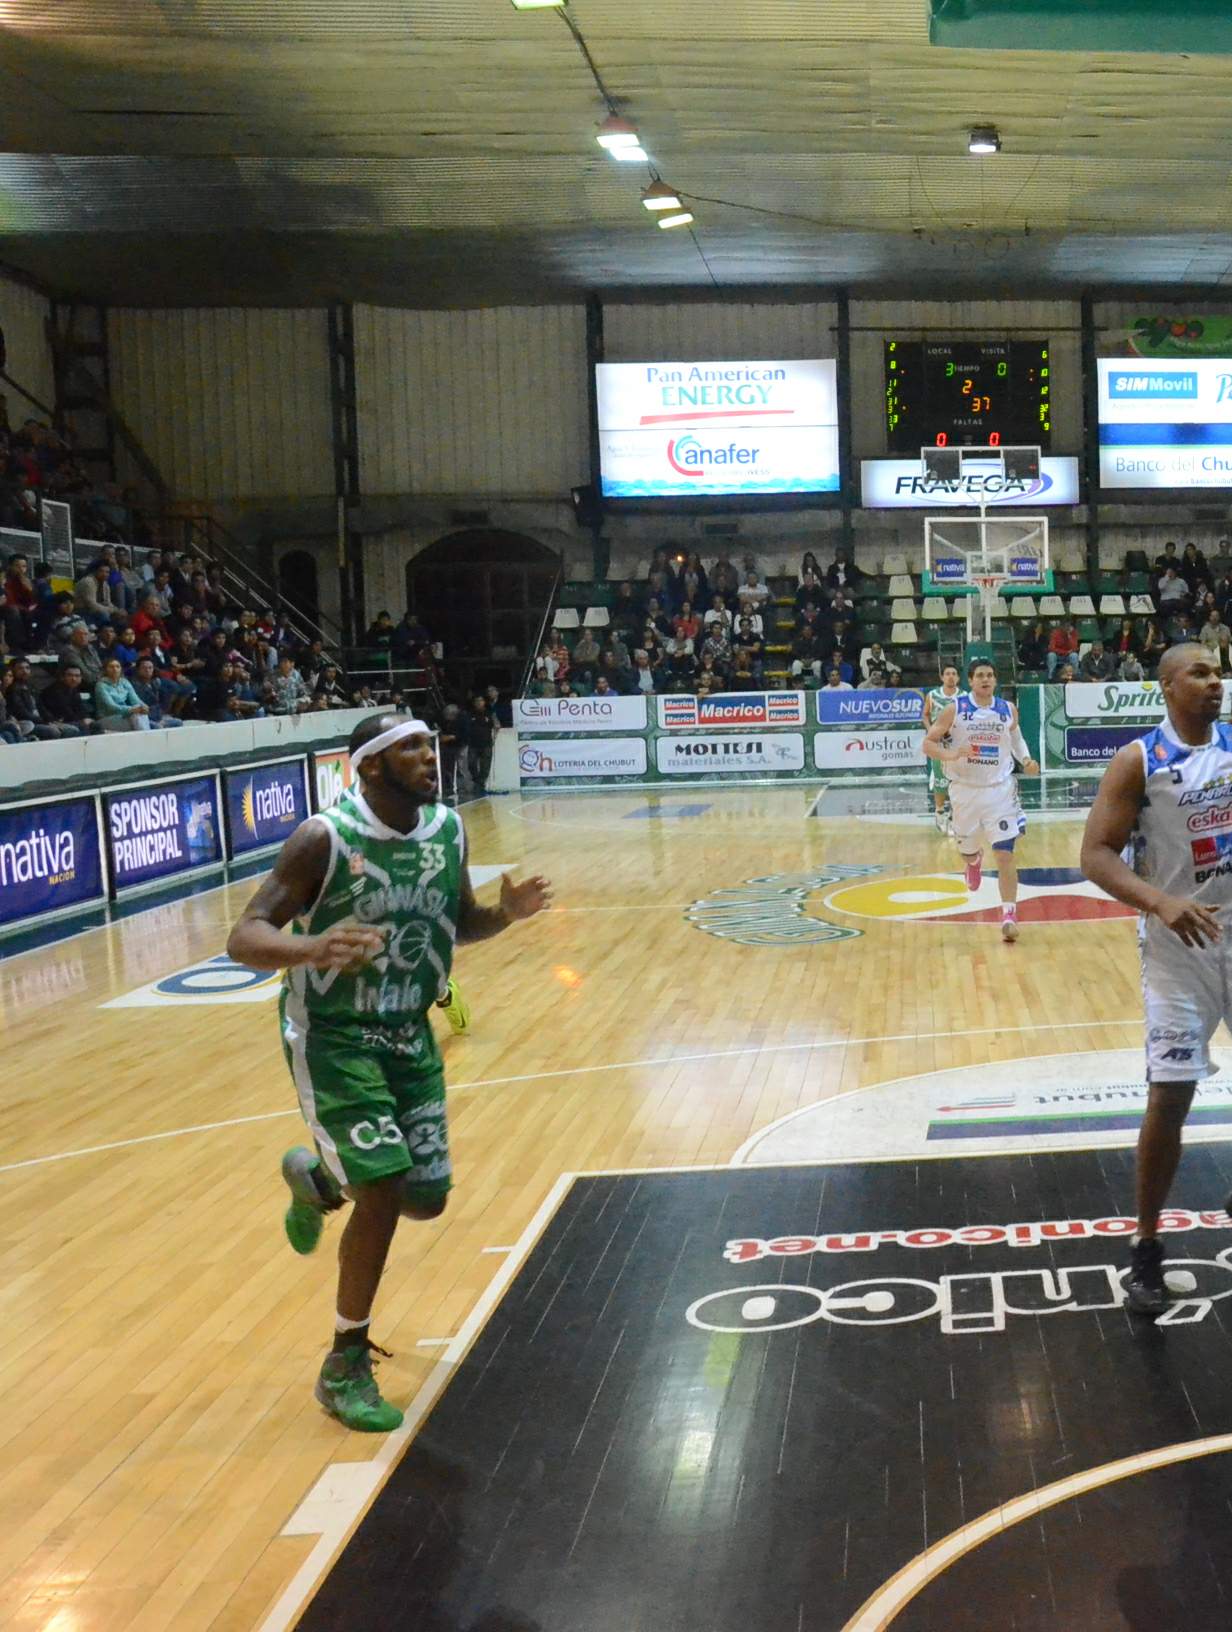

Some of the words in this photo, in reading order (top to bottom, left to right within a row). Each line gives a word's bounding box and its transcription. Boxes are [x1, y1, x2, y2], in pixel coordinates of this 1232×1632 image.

[927, 347, 952, 355] LOCAL
[646, 367, 682, 383] Pan
[688, 367, 787, 382] American
[1115, 376, 1193, 392] SIMMovil
[661, 385, 773, 406] ENERGY
[971, 396, 992, 412] 37
[1115, 457, 1166, 473] Banco
[557, 699, 613, 716] Penta
[700, 702, 764, 719] Macrico
[839, 699, 922, 714] NUEVOSUR
[881, 751, 914, 762] gomas
[1071, 746, 1100, 757] Banco
[587, 759, 602, 768] DEL
[603, 758, 636, 767] CHUBUT
[667, 755, 743, 767] materiales
[255, 780, 296, 822] nativa
[111, 792, 180, 838] SPONSOR
[0, 828, 75, 887] nativa
[114, 828, 183, 874] PRINCIPAL
[419, 842, 447, 870] 33
